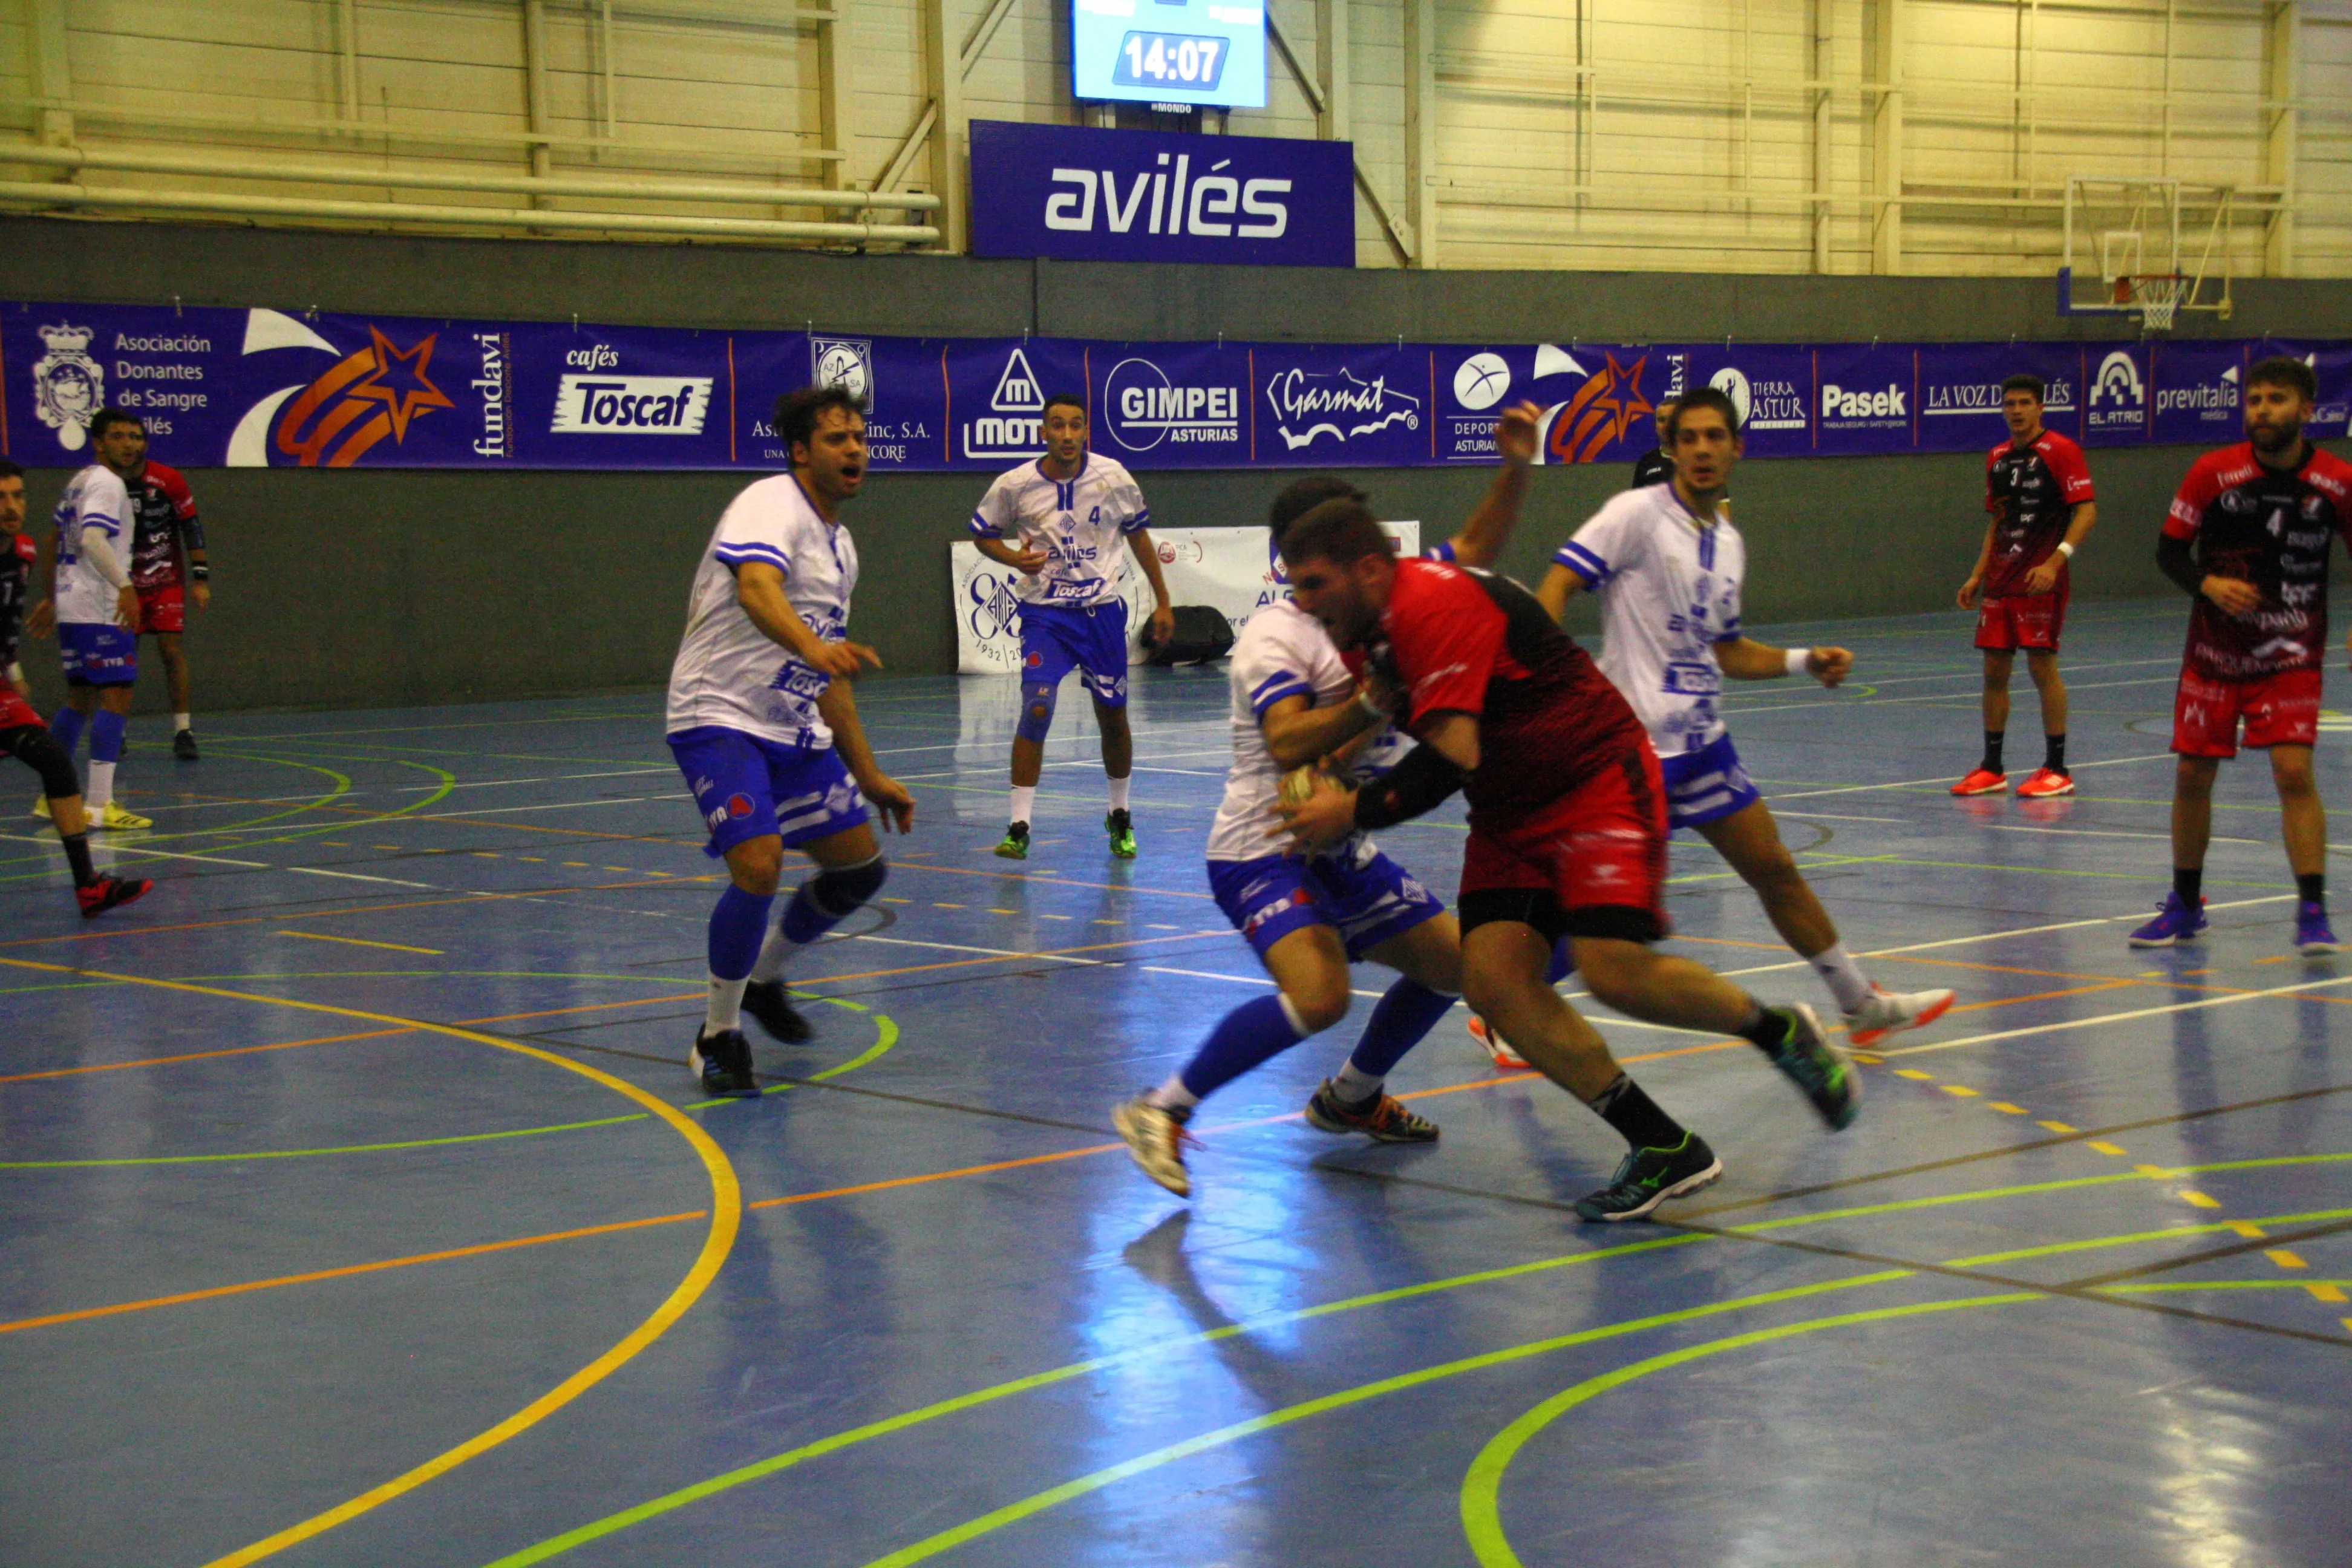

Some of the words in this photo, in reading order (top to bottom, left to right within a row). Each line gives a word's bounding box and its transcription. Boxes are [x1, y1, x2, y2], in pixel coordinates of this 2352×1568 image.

[1125, 36, 1219, 82] 14:07
[1157, 102, 1192, 114] MONDO
[1044, 152, 1292, 238] avilés
[115, 333, 211, 353] Asociación
[566, 344, 619, 371] cafés
[116, 361, 204, 379] Donantes
[118, 388, 142, 407] de
[145, 389, 207, 411] Sangre
[472, 333, 505, 458] fundavi
[1284, 368, 1384, 421] Garmat
[1753, 381, 1795, 396] TIERRA
[1929, 386, 1950, 407] LA
[1953, 385, 1987, 407] VOZ
[1990, 384, 2002, 406] D
[2156, 381, 2238, 416] previtalia
[575, 382, 694, 426] Toscaf
[1122, 387, 1238, 419] GIMPEI
[1751, 397, 1806, 419] ASTUR
[1822, 383, 1906, 417] Pasek
[142, 416, 172, 434] ilés
[2089, 411, 2106, 423] EL
[2108, 410, 2143, 423] ATRIO
[901, 422, 930, 439] S.A.
[1171, 428, 1238, 442] ASTURIAS
[764, 449, 785, 459] UNA
[1088, 505, 1101, 526] 4
[1053, 579, 1102, 598] Toscaf
